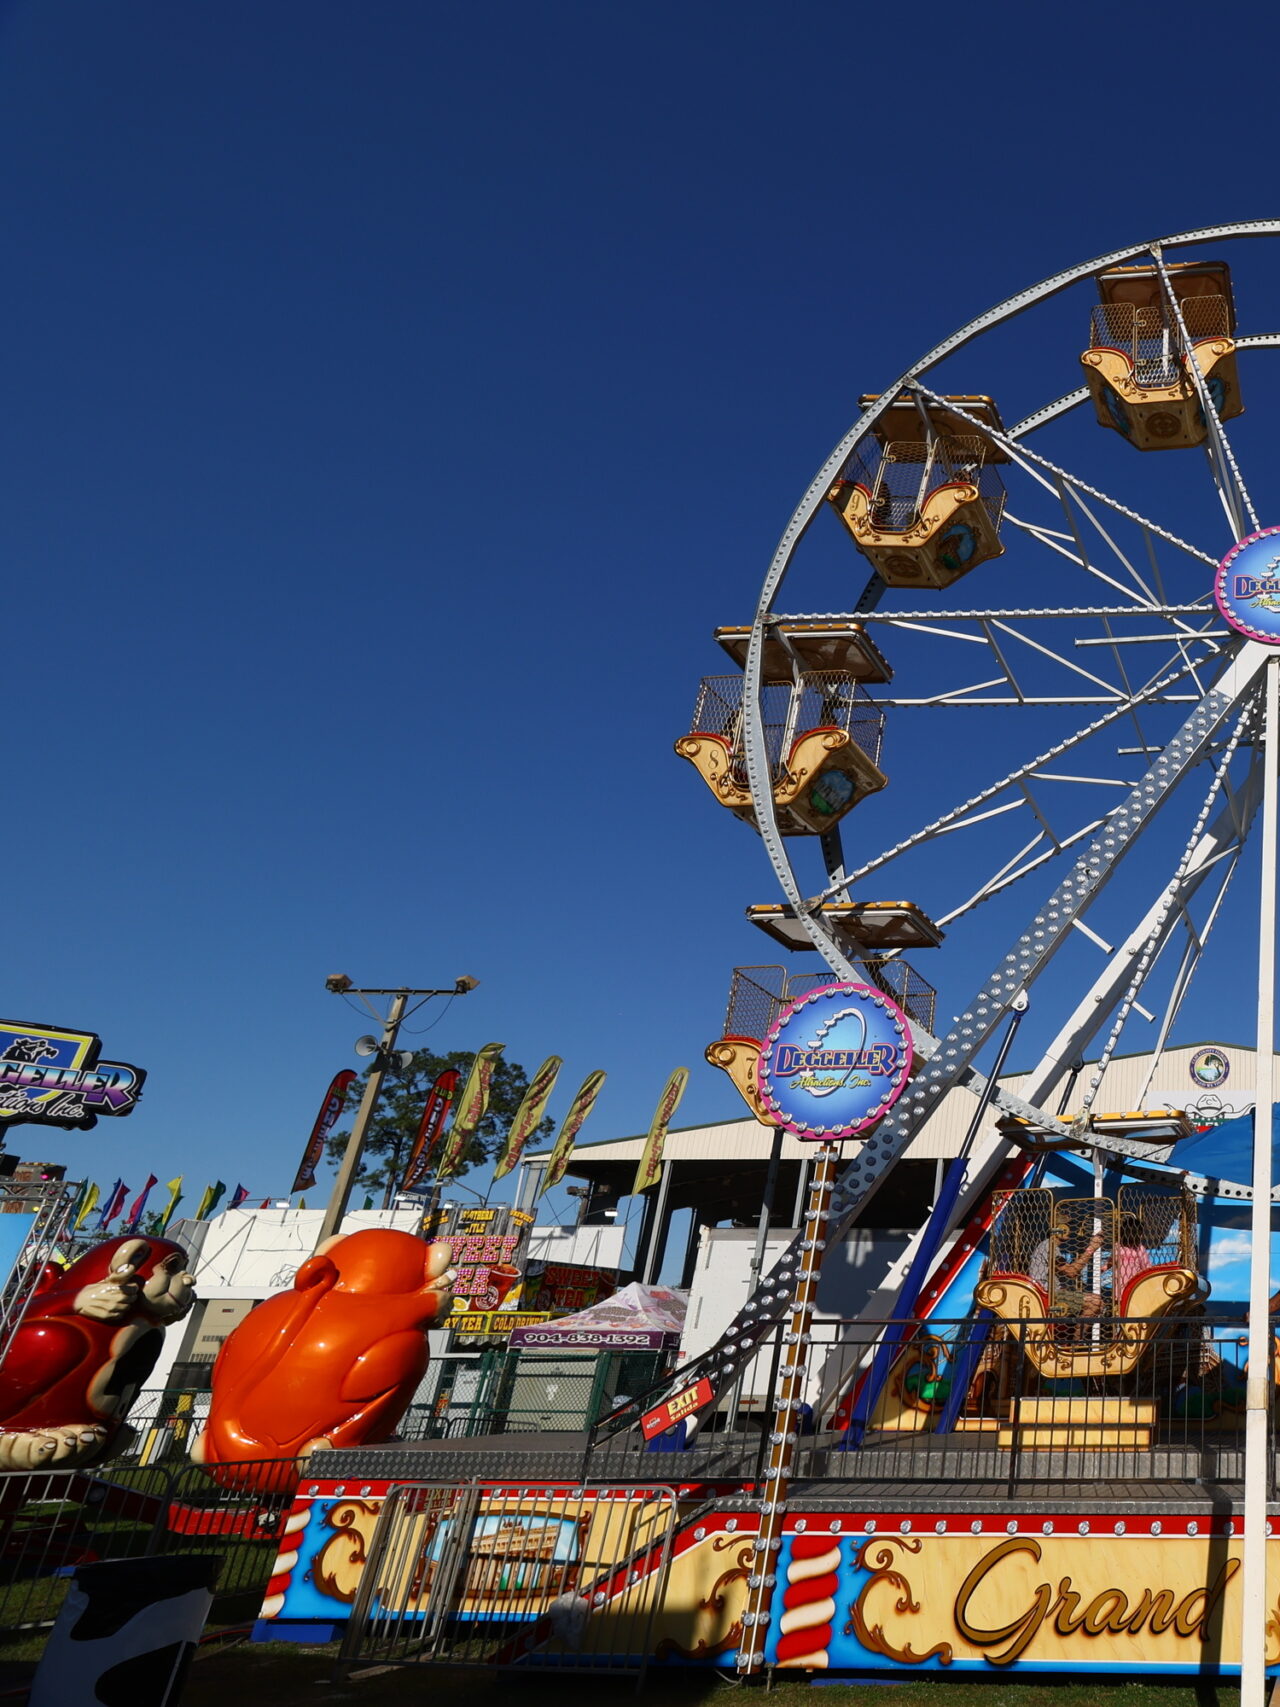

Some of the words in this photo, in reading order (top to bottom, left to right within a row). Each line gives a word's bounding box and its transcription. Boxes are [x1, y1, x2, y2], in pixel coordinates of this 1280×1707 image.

[708, 749, 719, 769] 8
[775, 1043, 898, 1076] DEGGELLER
[848, 1076, 871, 1088] Inc.
[545, 1266, 601, 1287] SWEET
[461, 1317, 483, 1331] TEA
[493, 1317, 514, 1331] COLD
[524, 1333, 650, 1345] 904-838-1392
[667, 1386, 698, 1416] EXIT
[670, 1402, 698, 1421] Salida
[954, 1536, 1241, 1667] Grand
